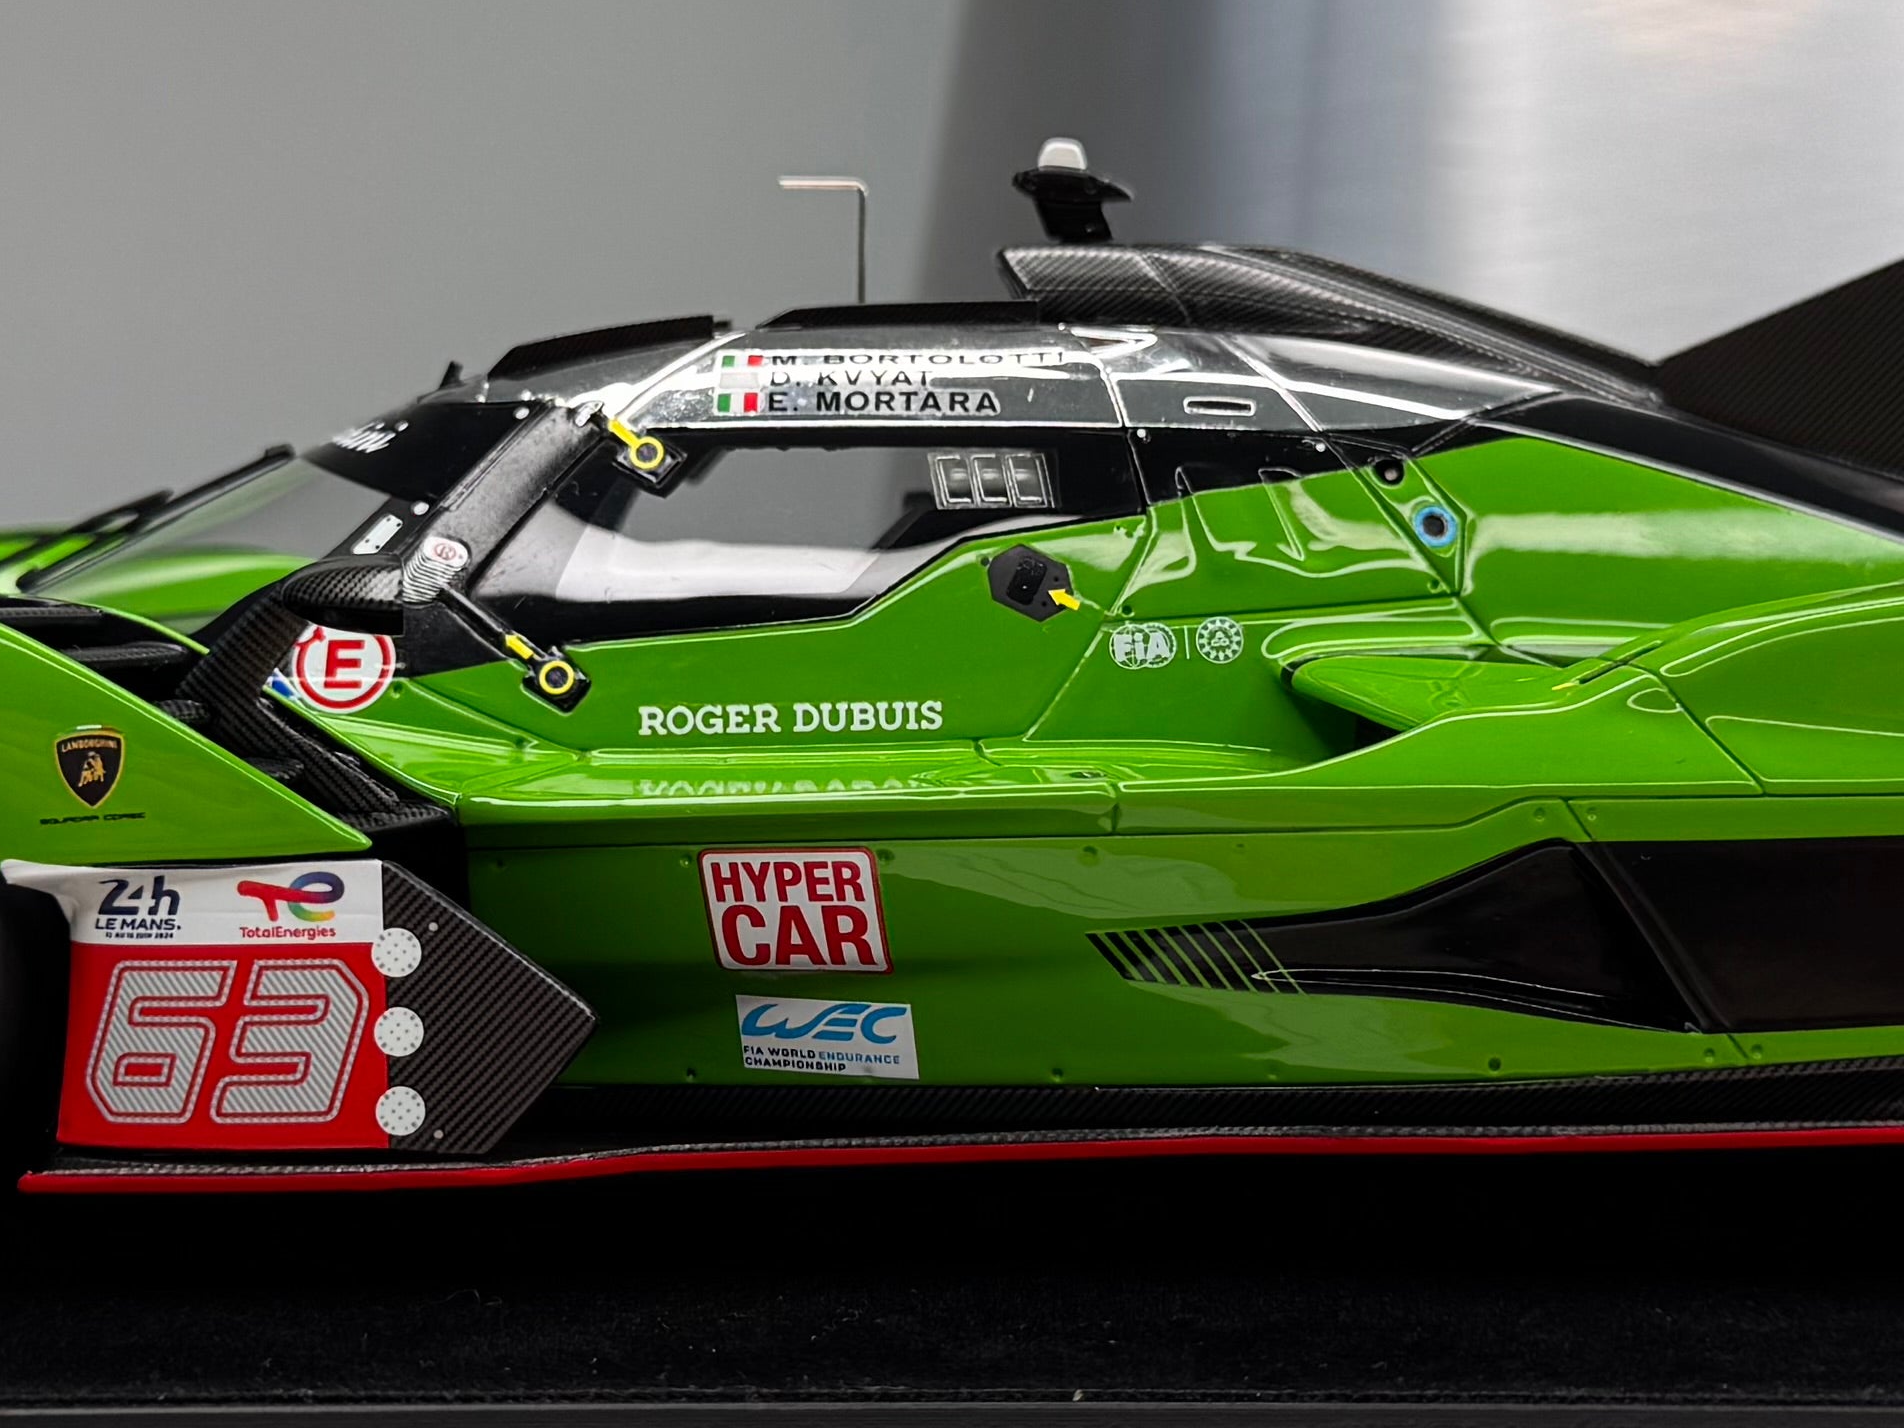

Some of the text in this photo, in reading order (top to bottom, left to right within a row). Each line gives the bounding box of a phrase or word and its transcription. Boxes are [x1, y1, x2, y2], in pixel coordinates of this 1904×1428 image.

[816, 371, 932, 387] KVYAT
[768, 391, 999, 413] E. MORTARA
[323, 639, 365, 689] E
[638, 700, 943, 736] ROGER DUBUIS
[709, 861, 866, 904] HYPER
[95, 918, 118, 932] LE
[239, 925, 337, 941] TotalEnergies
[720, 904, 878, 968] CAR
[741, 1003, 907, 1045] WEC
[86, 958, 370, 1124] 63
[743, 1045, 900, 1065] FIA WORLD ENDURANCE
[745, 1056, 846, 1071] CHAMPIONSHIP
